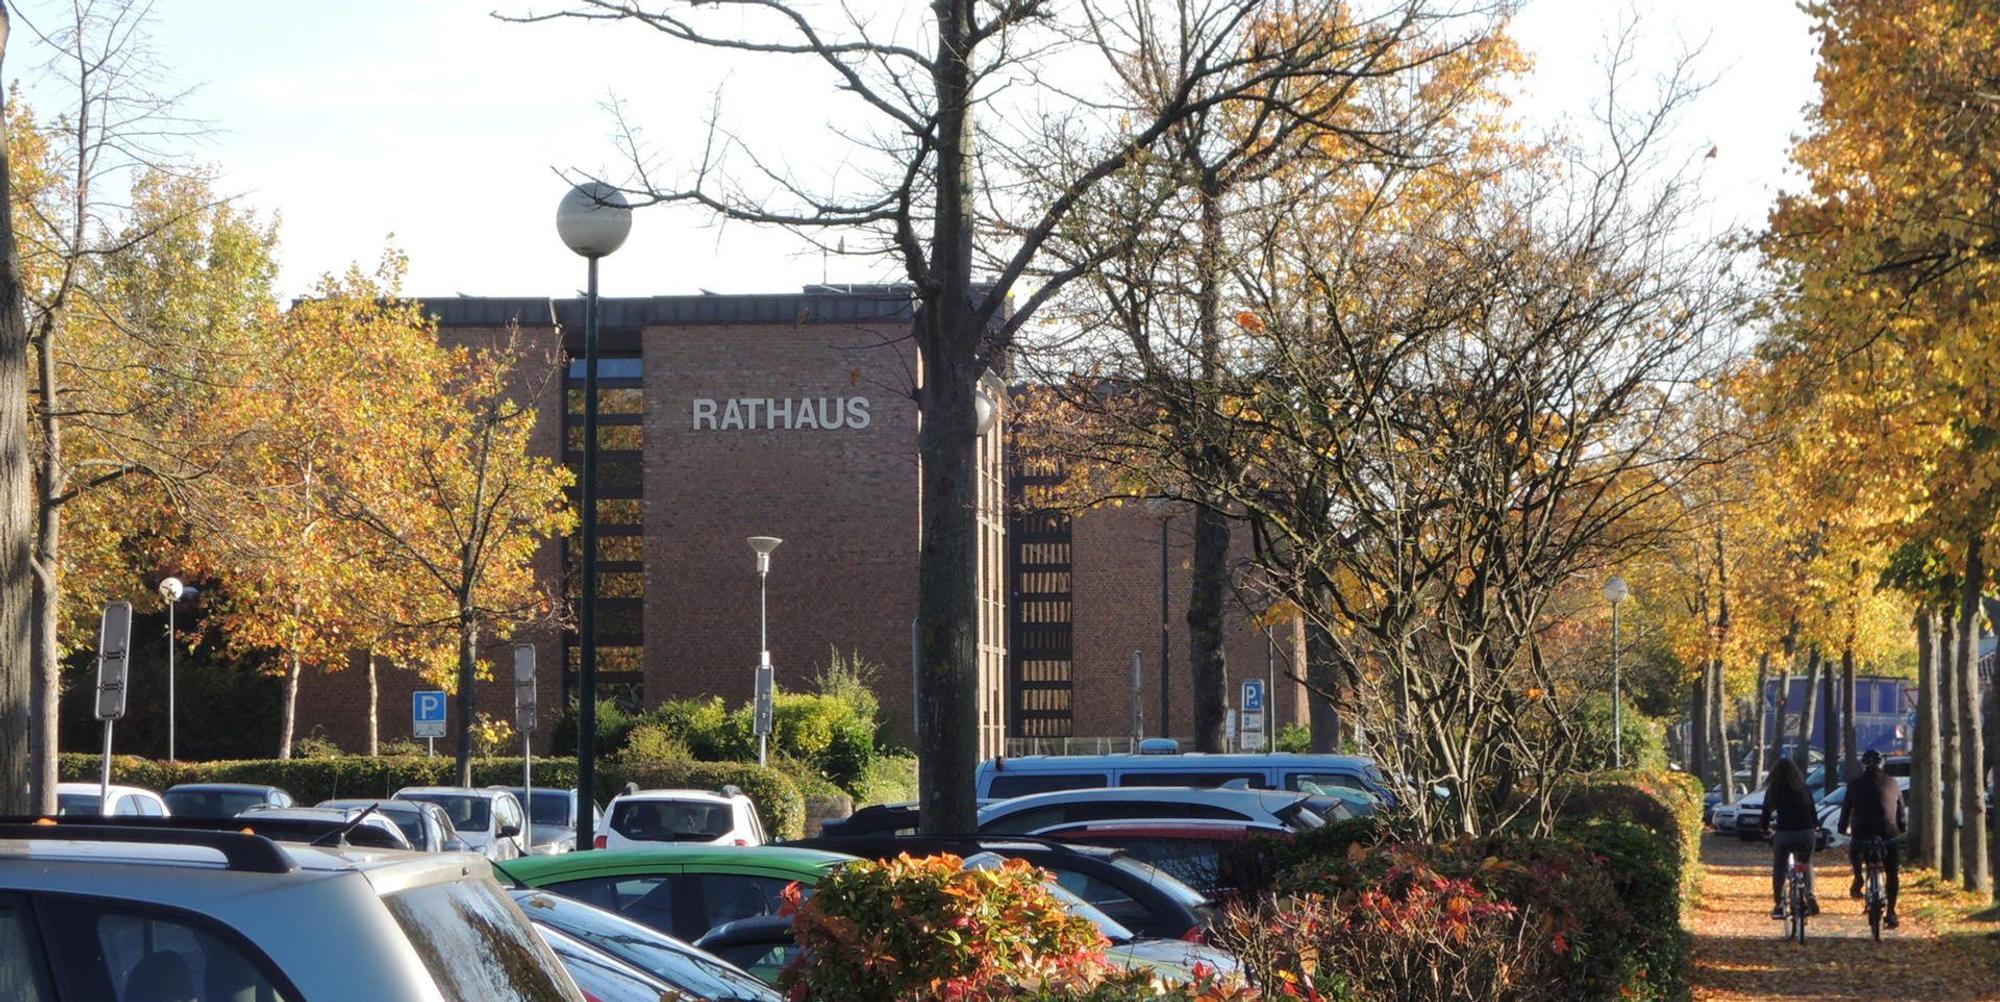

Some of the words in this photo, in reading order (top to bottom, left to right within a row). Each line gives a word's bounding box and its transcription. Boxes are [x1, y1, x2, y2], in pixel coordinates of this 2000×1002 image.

[692, 396, 871, 430] RATHAUS
[421, 695, 439, 720] P
[1246, 686, 1257, 707] P
